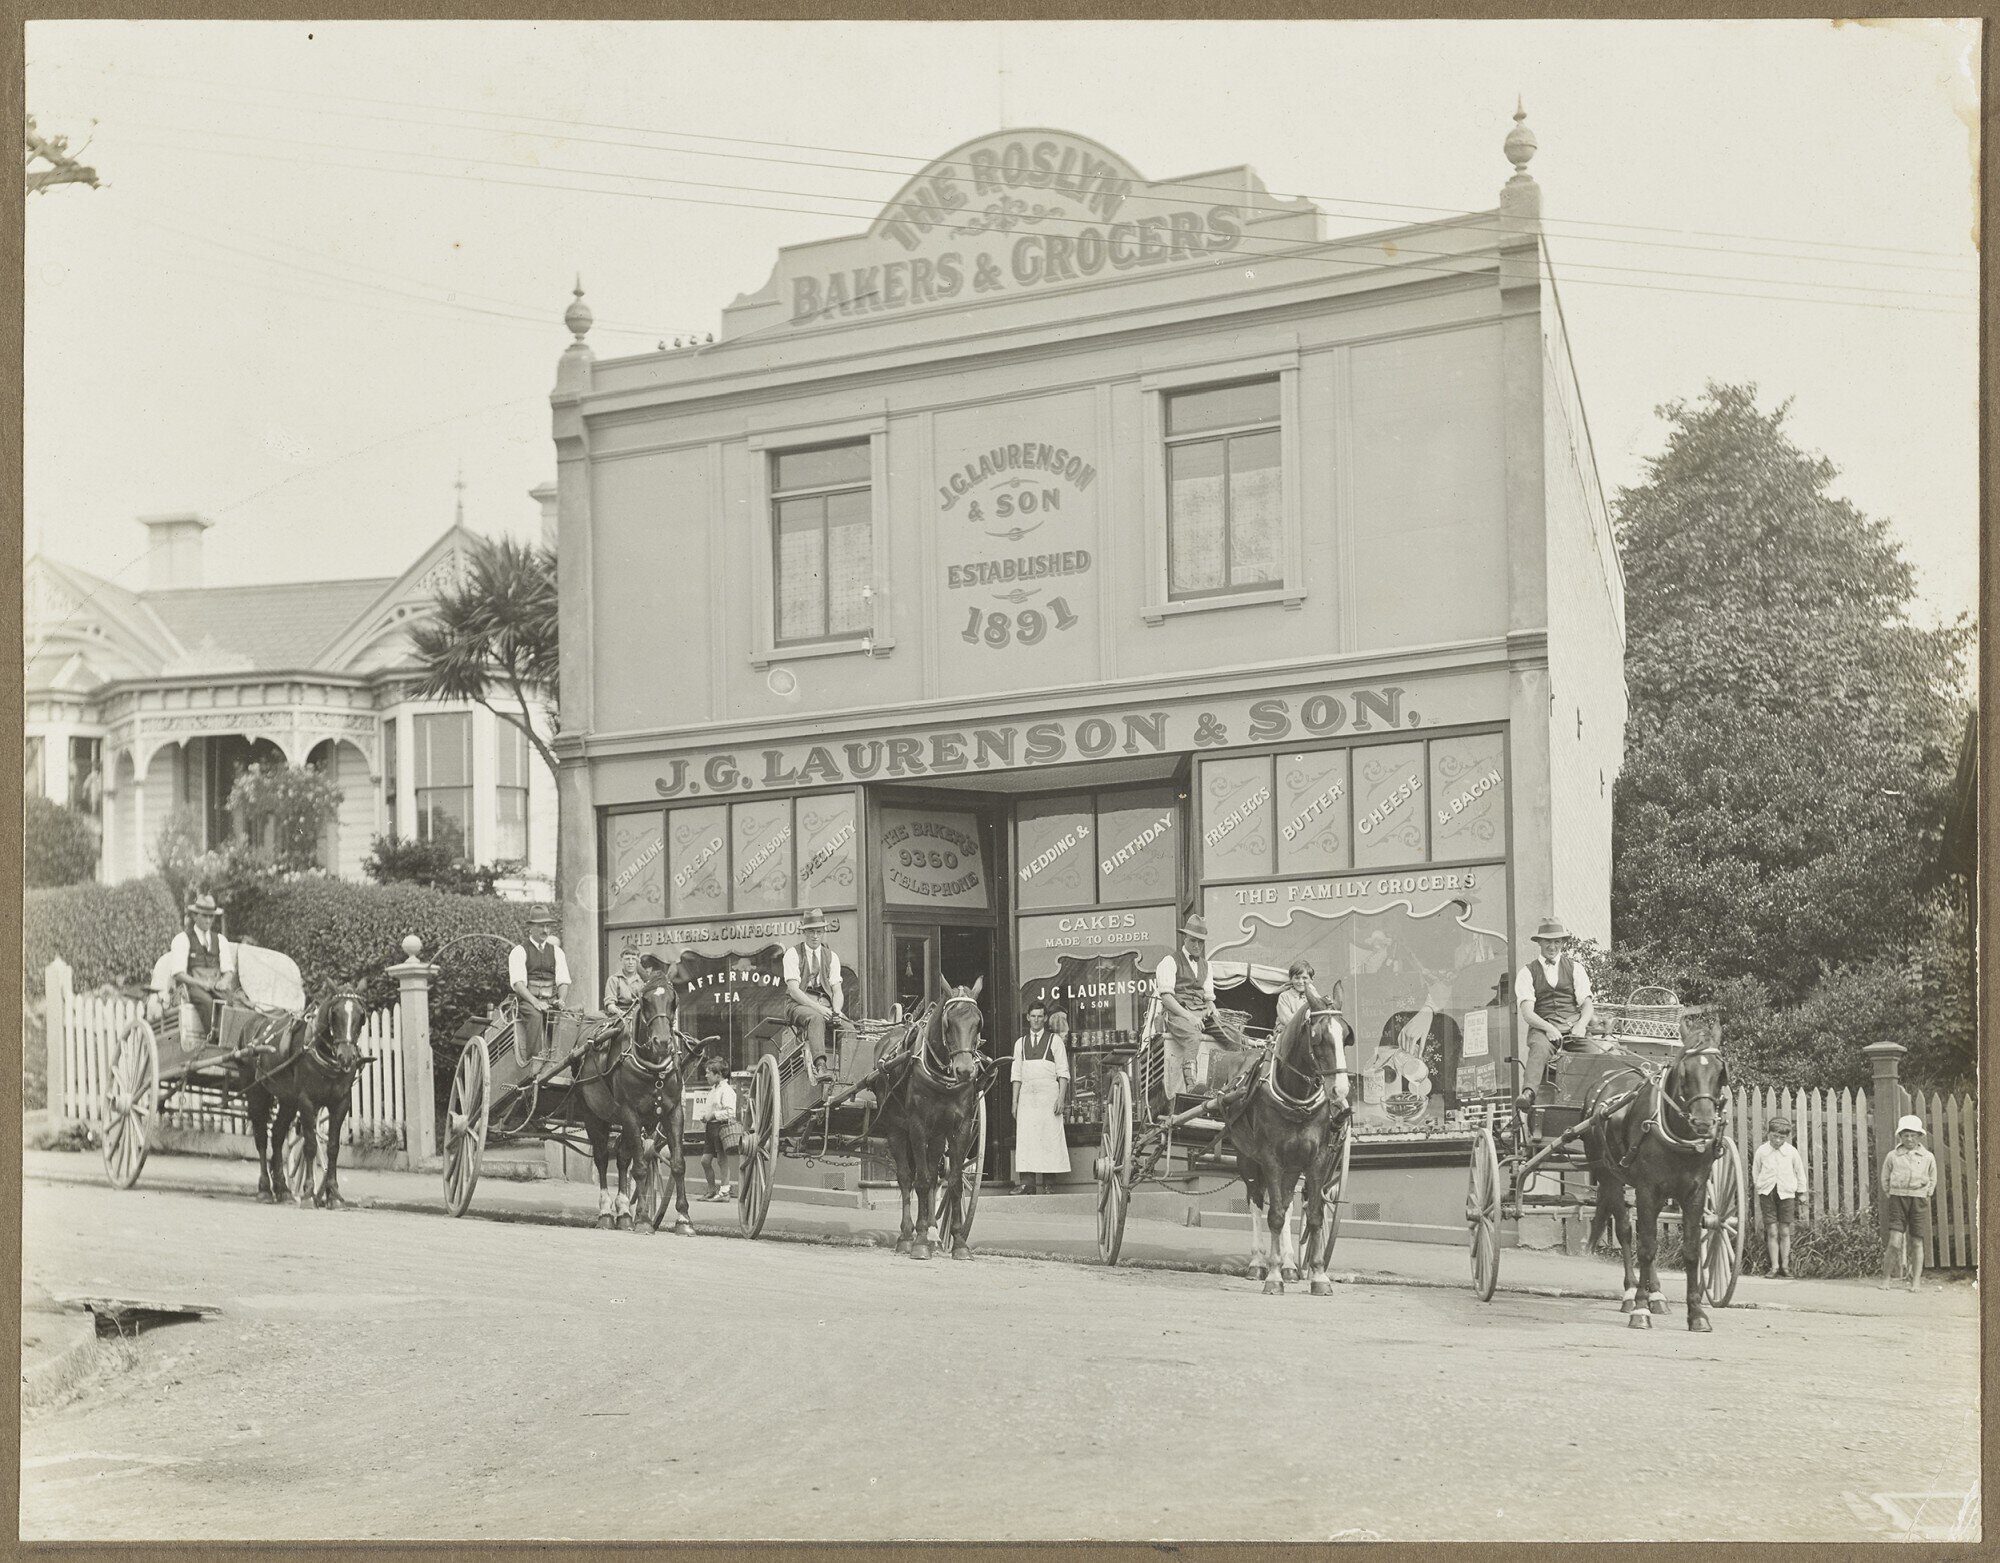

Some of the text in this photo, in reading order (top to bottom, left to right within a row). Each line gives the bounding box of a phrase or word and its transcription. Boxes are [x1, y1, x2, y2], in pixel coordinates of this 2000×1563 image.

[879, 140, 1132, 252] THE ROSLYN
[790, 203, 1242, 327] BAKERS & GROCERS
[967, 487, 1061, 523] & SON
[947, 549, 1092, 590] ESTABLISHED
[961, 596, 1079, 650] 1891
[760, 711, 1170, 789] LAURENSON
[1193, 712, 1229, 747] &
[1204, 786, 1271, 848] FRESH EGGS
[1281, 784, 1345, 841] BUTTER
[1357, 774, 1424, 835] CHEESE
[1437, 769, 1504, 826] & BACON
[800, 819, 857, 882] SPECIALITY
[880, 824, 909, 849] THE
[899, 849, 959, 870] 9360
[1018, 824, 1091, 882] WEDDING &
[1101, 812, 1174, 875] BIRTHDAY
[609, 838, 664, 896] BERMALINE
[673, 837, 724, 888] BREAD
[889, 868, 980, 897] TELEPHONE
[1235, 873, 1477, 905] THE FAMILY GROCERS
[621, 917, 841, 947] THE BAKERS & CONFECTIONS
[1045, 931, 1150, 948] MADE TO ORDER
[1058, 913, 1137, 932] CAKES
[687, 971, 781, 993] AFTERNOON
[714, 992, 741, 1004] TEA
[1067, 978, 1158, 999] LAURENSON
[1080, 1000, 1110, 1010] & SON
